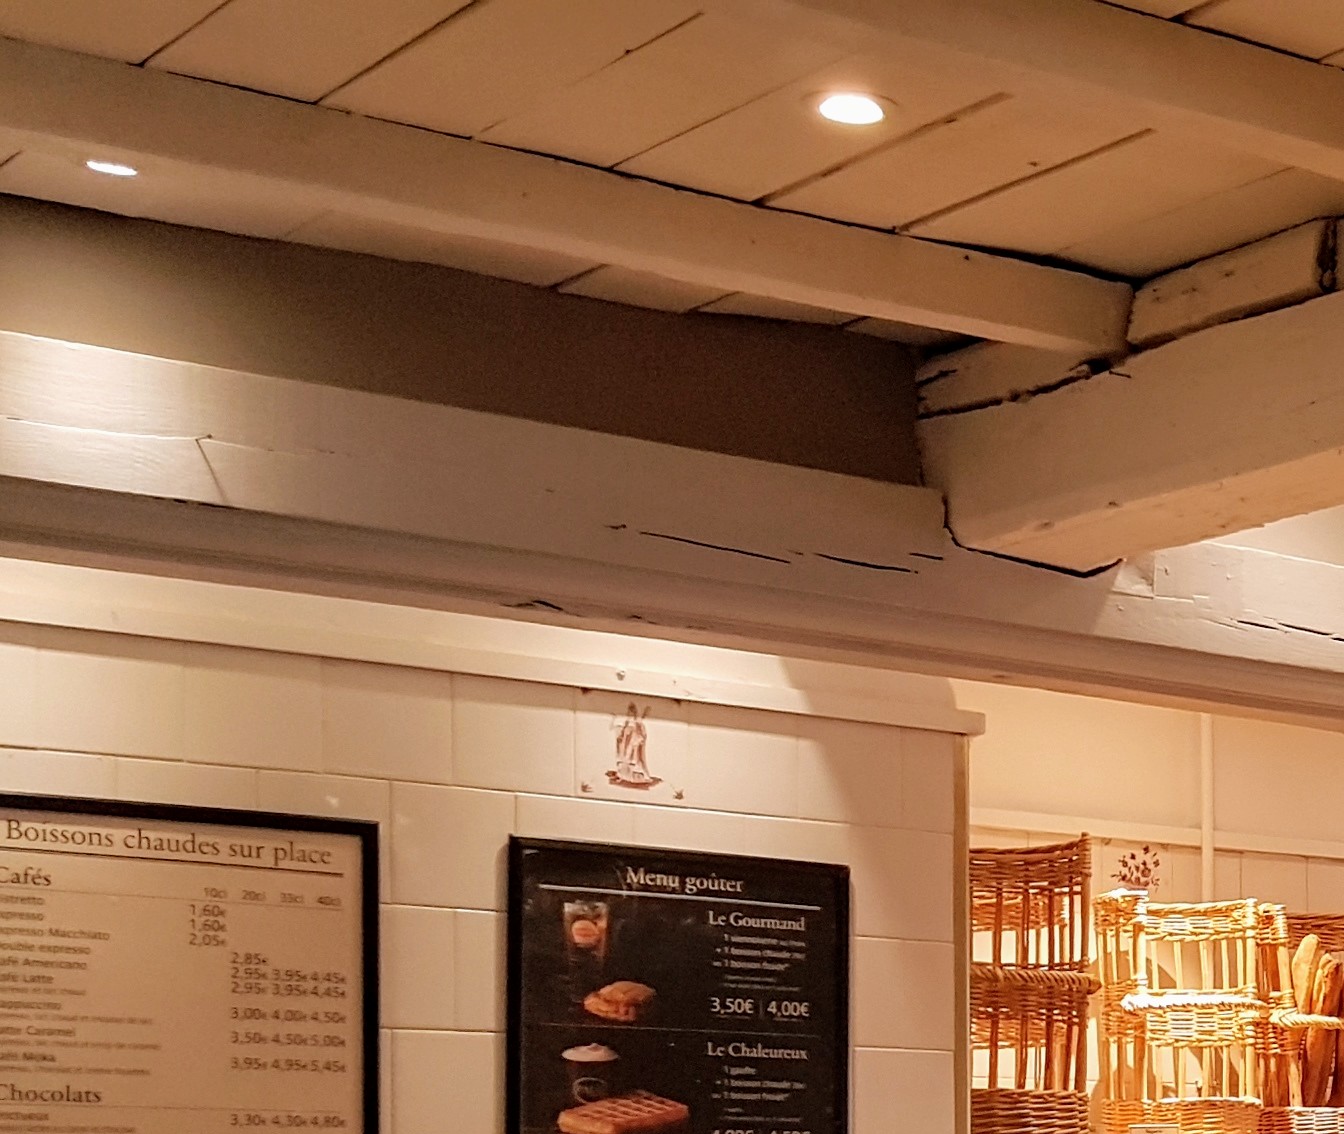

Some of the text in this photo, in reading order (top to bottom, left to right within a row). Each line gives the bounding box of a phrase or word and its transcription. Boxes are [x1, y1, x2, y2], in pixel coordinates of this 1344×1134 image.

[6, 819, 331, 866] Boissons chaudes sur place
[626, 866, 744, 894] Menu goûter
[708, 910, 805, 931] Le Gourmand
[711, 997, 810, 1017] 3,50€ 4,00€
[707, 1041, 809, 1060] Le Chaleureux
